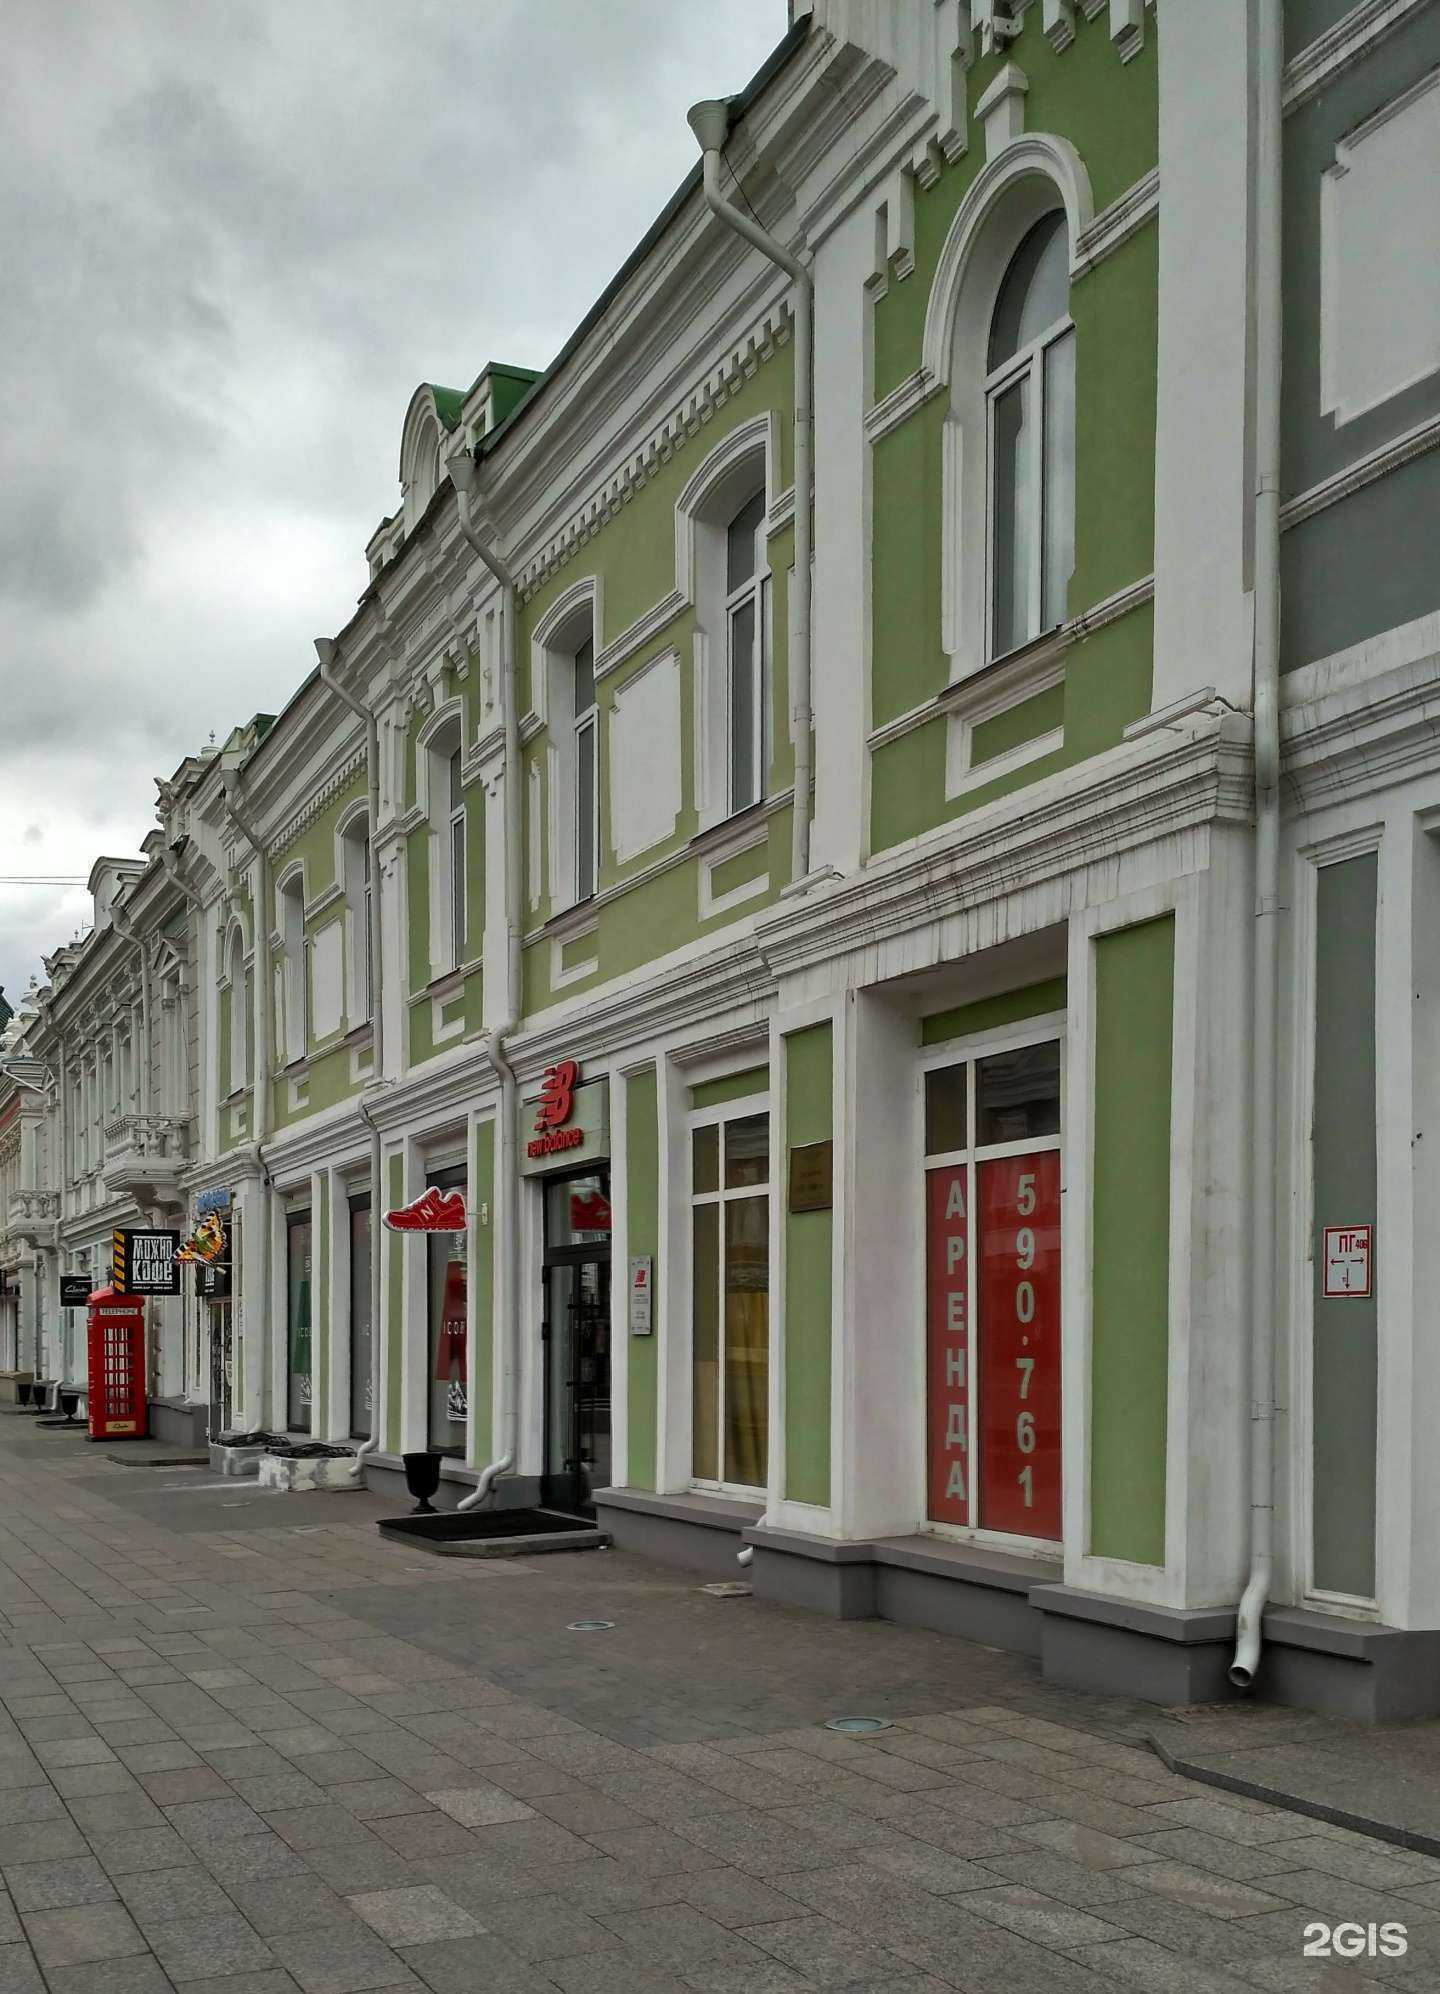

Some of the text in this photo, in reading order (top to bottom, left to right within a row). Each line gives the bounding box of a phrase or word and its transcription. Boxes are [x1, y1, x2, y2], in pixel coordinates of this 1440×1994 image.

[527, 1128, 584, 1159] new balance
[132, 1239, 172, 1260] МОЖНО
[132, 1260, 173, 1282] КОФЕ
[945, 1180, 967, 1500] АРЕНДА
